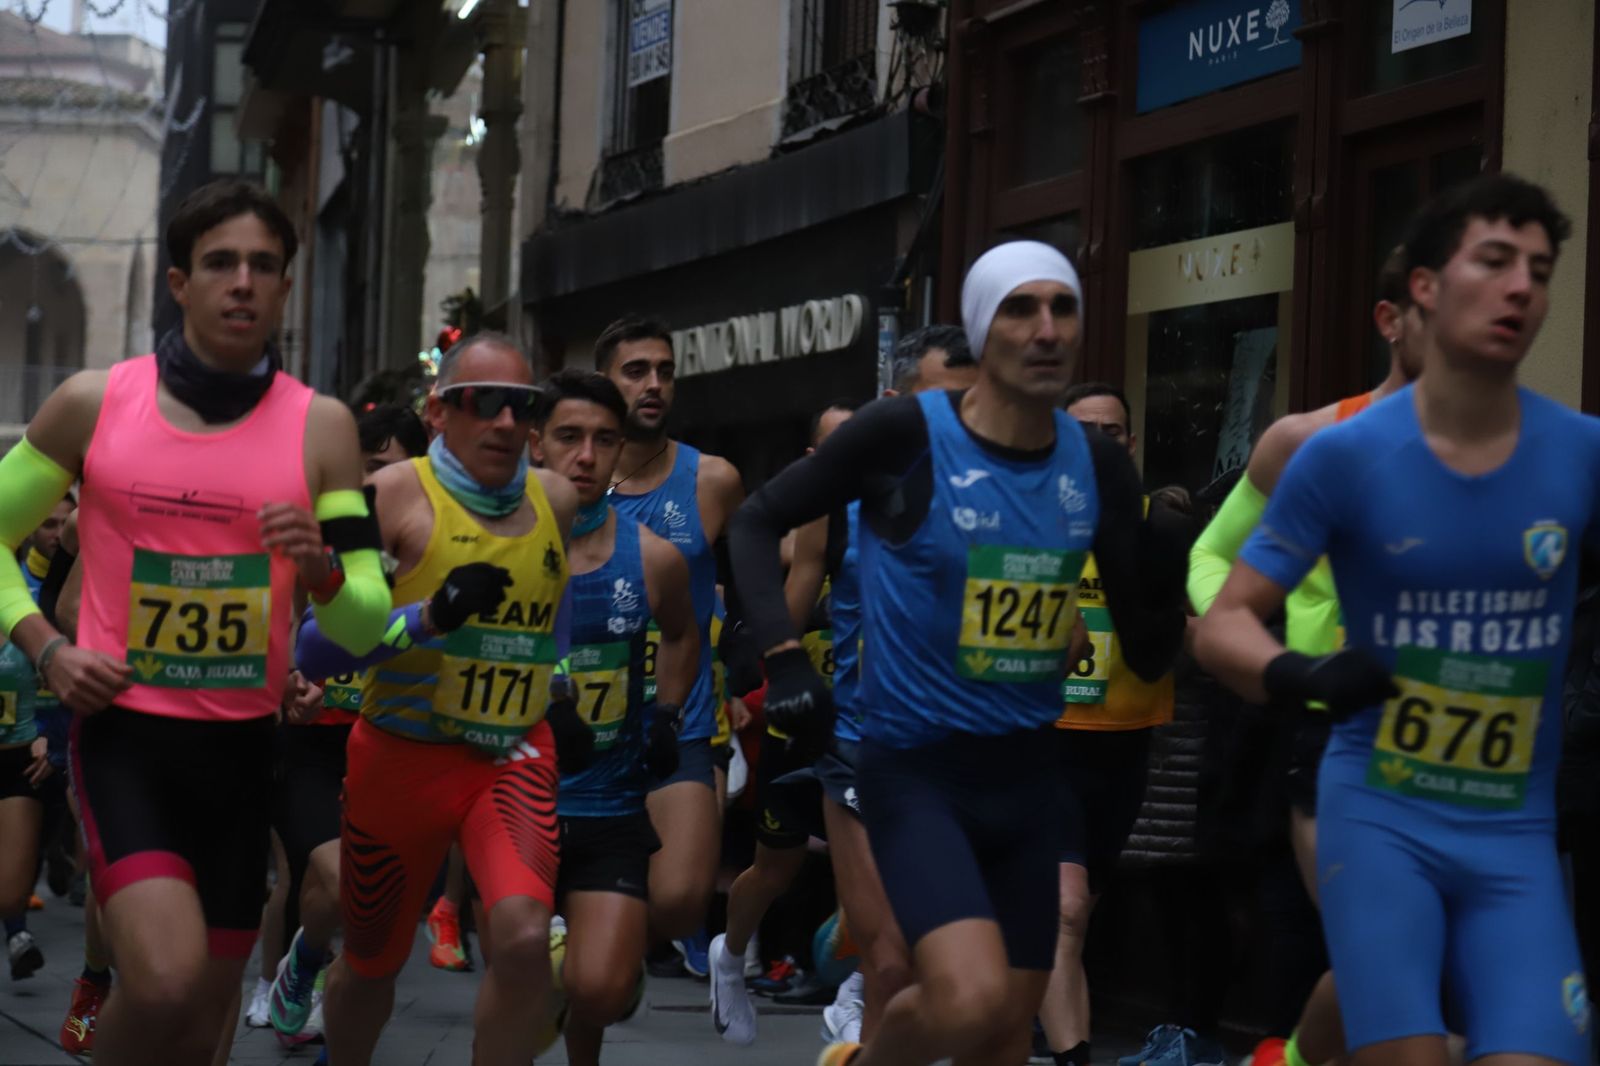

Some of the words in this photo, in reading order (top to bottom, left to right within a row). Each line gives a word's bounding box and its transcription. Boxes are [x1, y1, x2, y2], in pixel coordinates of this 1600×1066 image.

[1189, 8, 1260, 60] NUXE
[1402, 27, 1425, 41] Origen
[1426, 23, 1435, 35] de
[1436, 21, 1443, 33] la
[1444, 15, 1469, 31] Belleza
[1179, 243, 1243, 281] NUXE
[780, 293, 863, 359] WORLD
[976, 586, 1068, 639] 1247
[1397, 587, 1549, 615] ATLETISMO
[140, 598, 247, 653] 735
[1373, 612, 1439, 649] LAS
[1452, 612, 1563, 653] ROZAS
[165, 663, 202, 680] CAJA
[205, 664, 259, 679] RURAL
[459, 664, 534, 716] 1171
[1065, 685, 1102, 697] RURAL
[585, 682, 612, 721] 7
[464, 730, 500, 746] CAJA
[1394, 697, 1517, 768] 676
